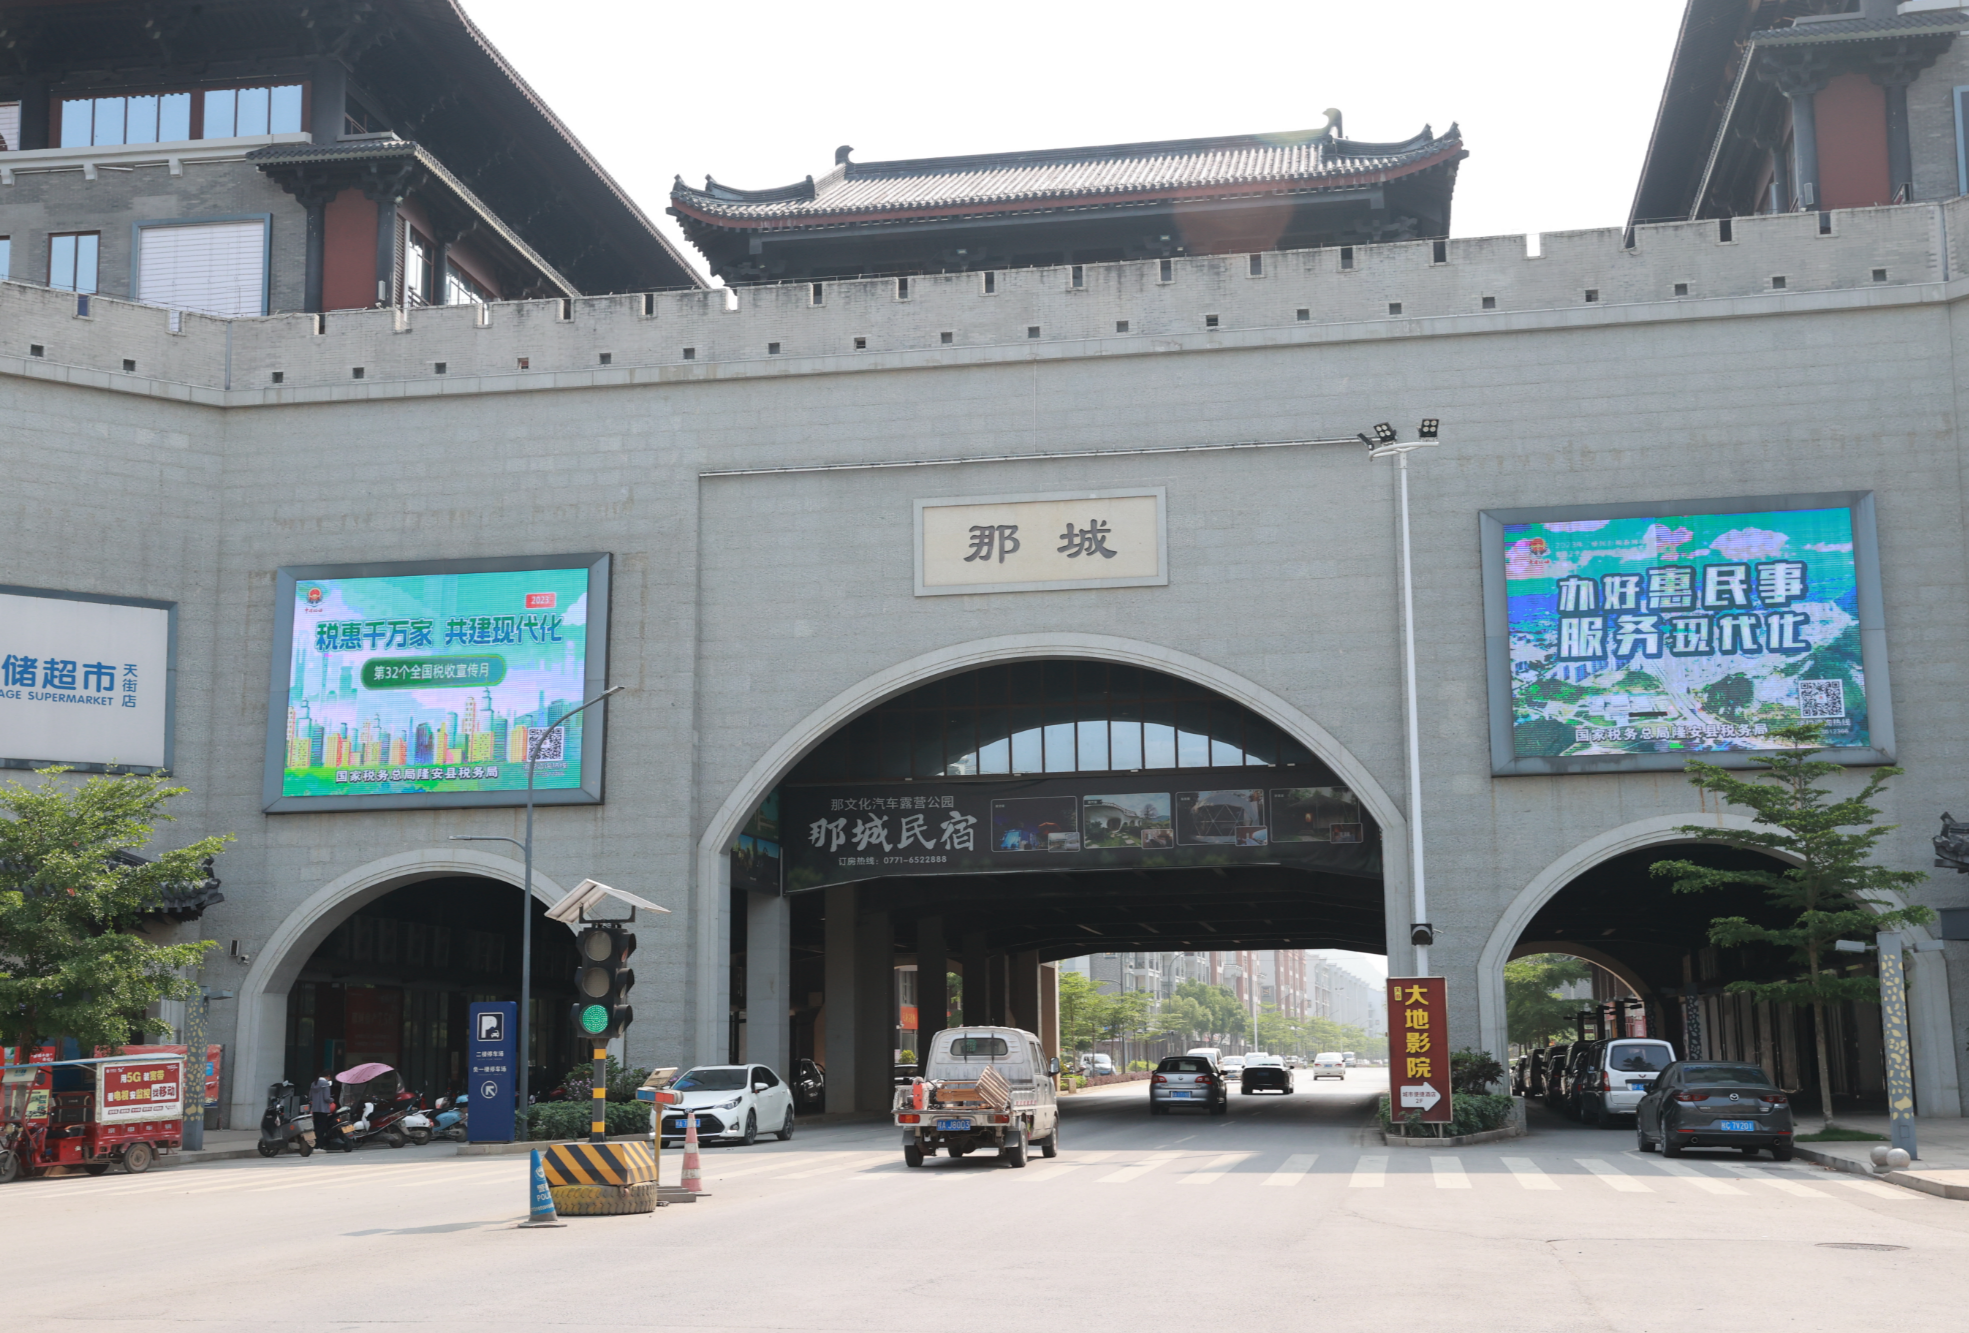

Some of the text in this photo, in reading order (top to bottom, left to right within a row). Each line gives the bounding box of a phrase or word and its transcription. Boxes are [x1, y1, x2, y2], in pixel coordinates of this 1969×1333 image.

[963, 518, 1118, 564] 那城
[531, 595, 550, 605] 2023
[1559, 561, 1805, 611] 办好惠民事
[315, 614, 563, 651] 税惠千万家 共建现代化
[1560, 614, 1809, 658] 服务现代化
[1, 654, 117, 693] 储超市
[121, 663, 138, 708] 天街店
[373, 662, 489, 681] 第32个全国税收宣传月
[28, 691, 114, 706] SUPERMARKET
[1575, 724, 1769, 742] 国家税务总局隆安县税务局
[336, 766, 498, 783] 国家税务总局隆安县税务局
[830, 796, 954, 811] 那文化汽车露营公园
[808, 810, 978, 852] 那城民宿
[1404, 984, 1432, 1078] 大地影院
